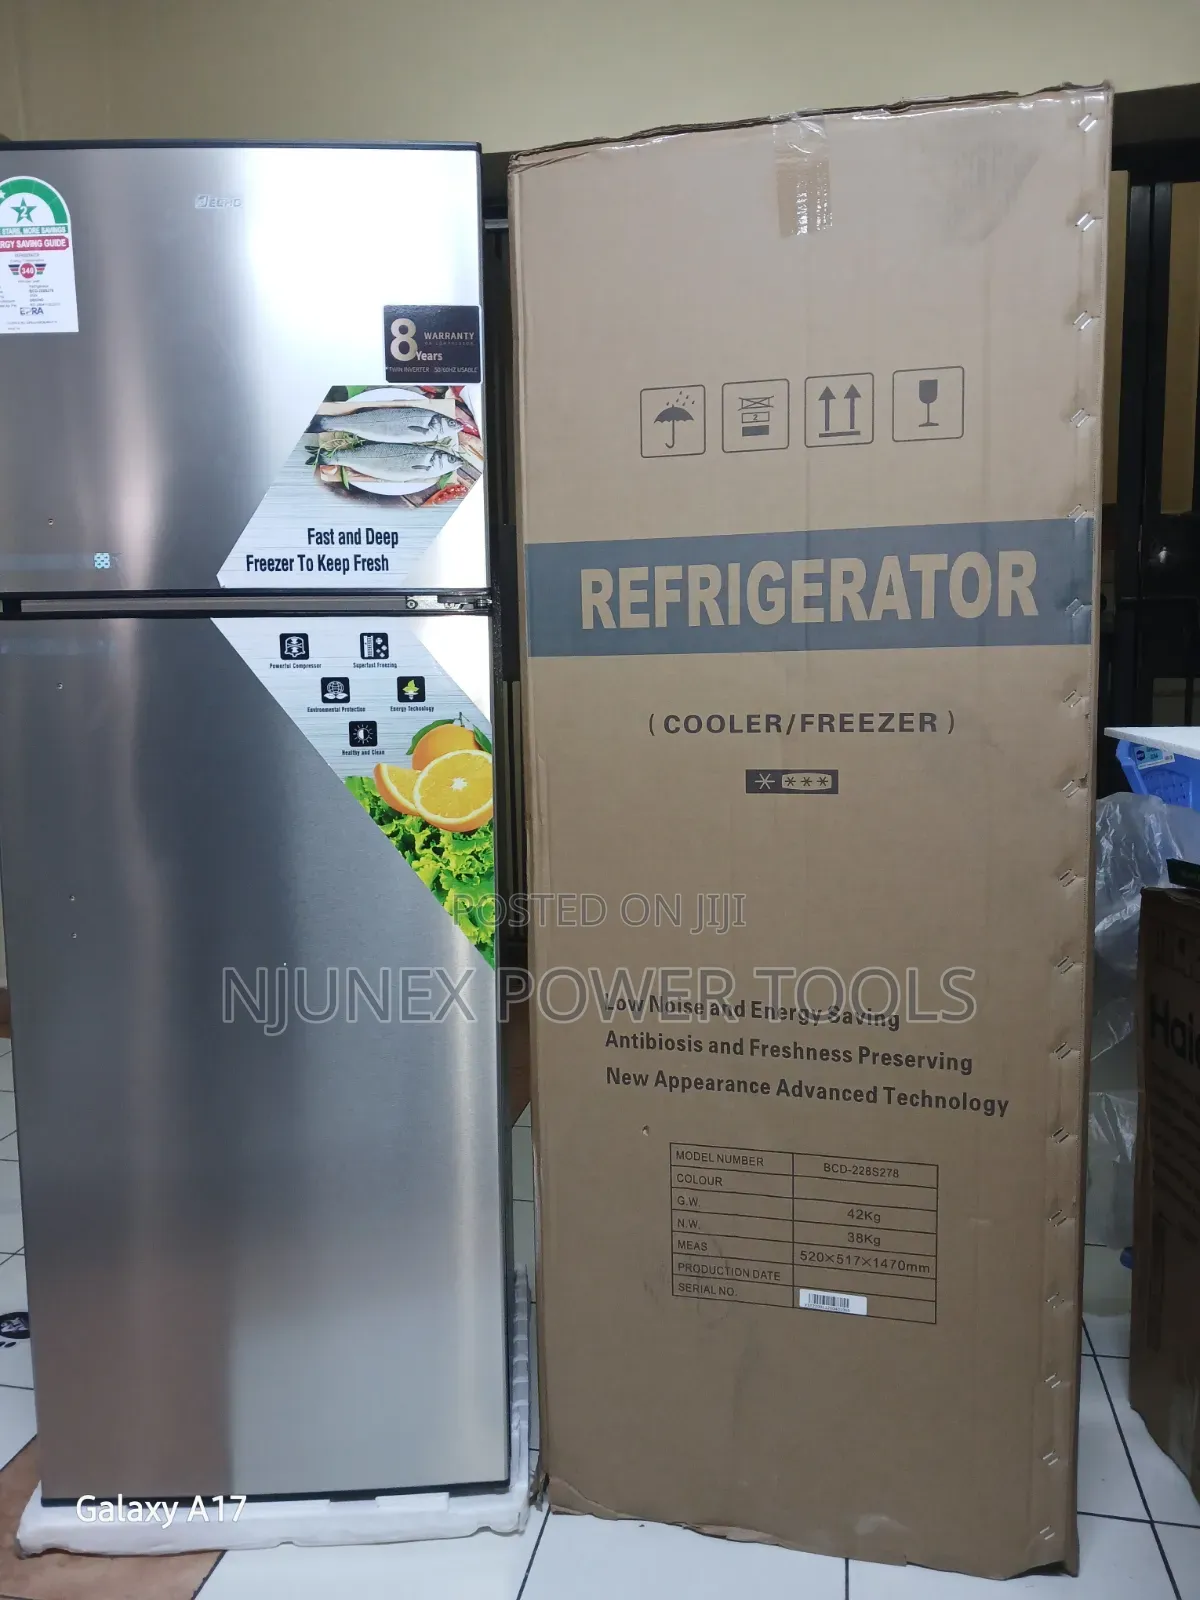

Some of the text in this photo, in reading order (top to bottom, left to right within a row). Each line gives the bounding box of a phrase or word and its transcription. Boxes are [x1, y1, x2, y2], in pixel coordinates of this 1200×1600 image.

[20, 206, 28, 217] 2
[16, 239, 43, 248] SAVING
[44, 238, 66, 247] GUIDE
[390, 318, 418, 361] 8
[423, 332, 475, 340] WARRANTY
[416, 350, 443, 361] Years
[307, 527, 399, 549] Fast and Deep
[246, 554, 389, 575] Freezer To Keep Fresh
[580, 550, 1039, 630] REFRIGERATOR
[292, 662, 322, 670] Compressor
[390, 705, 435, 713] Energy Technology
[342, 749, 360, 757] Healthy
[605, 993, 900, 1032] Low Noise and Energy Saving
[605, 1030, 973, 1075] Antibiosis and Freshness Preserving
[606, 1066, 1009, 1117] New Appearance Advanced Technology
[676, 1150, 764, 1166] MODEL NUMBER
[823, 1162, 900, 1178] BCD-228S278
[676, 1173, 723, 1186] COLOUR
[846, 1208, 881, 1223] 42Kg
[677, 1239, 708, 1252] MEAS
[847, 1232, 881, 1246] 38Kg
[678, 1262, 781, 1281] PRODUCTION DATE
[678, 1282, 738, 1297] SERIAL NO.
